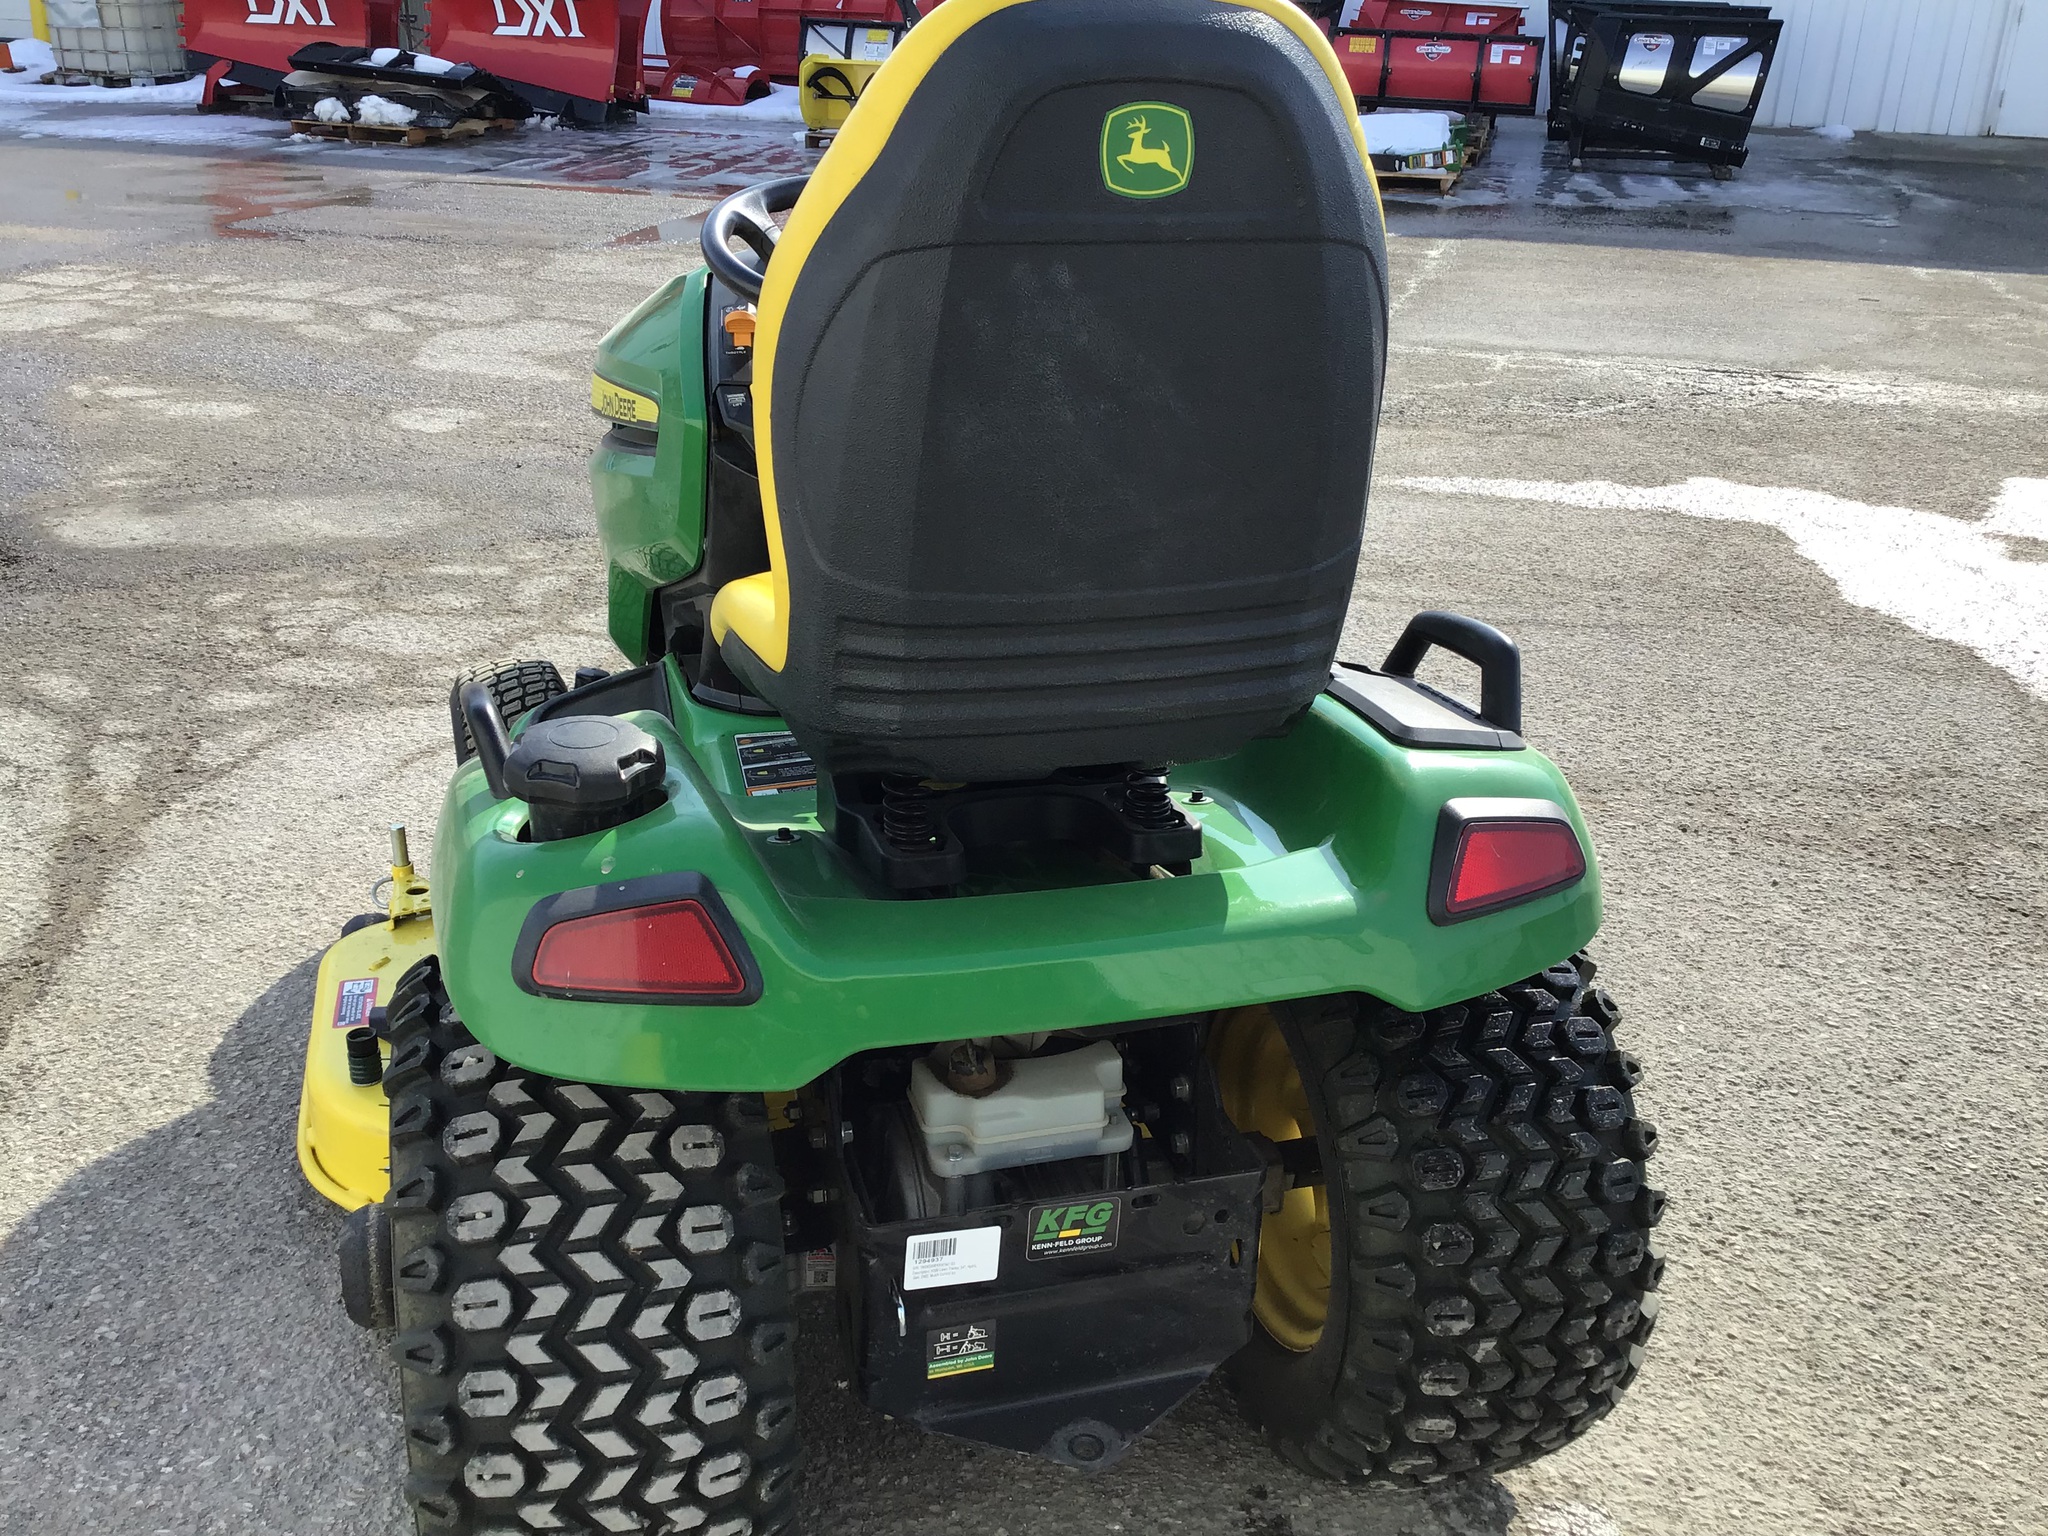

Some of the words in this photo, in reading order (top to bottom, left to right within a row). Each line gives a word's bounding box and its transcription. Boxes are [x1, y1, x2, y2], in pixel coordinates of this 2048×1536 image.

[614, 391, 636, 421] DEERE
[1035, 1202, 1114, 1233] KFG
[1031, 1239, 1074, 1251] KENN-FELD
[1075, 1235, 1103, 1245] GROUP
